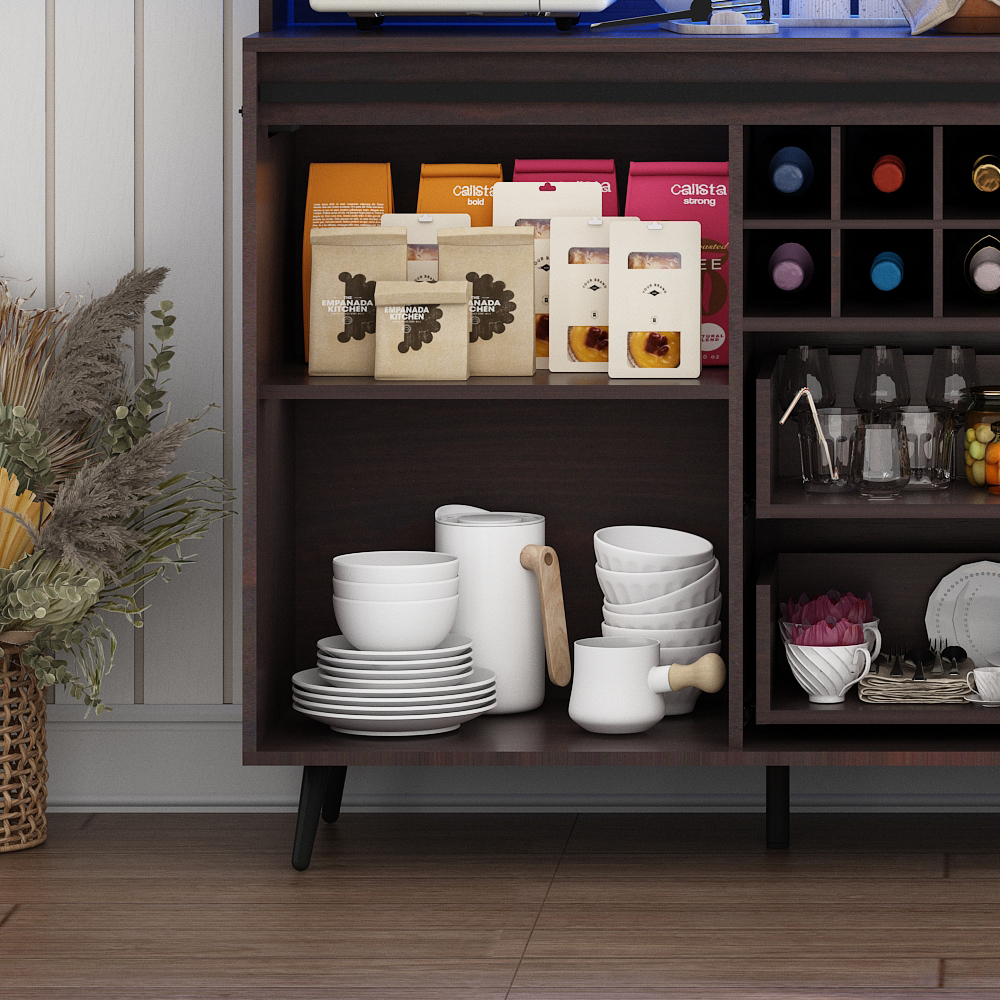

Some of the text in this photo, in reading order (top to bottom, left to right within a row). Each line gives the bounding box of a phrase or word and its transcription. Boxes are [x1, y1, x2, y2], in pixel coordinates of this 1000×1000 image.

[467, 197, 485, 206] bold
[683, 197, 716, 207] strong
[701, 241, 730, 251] asted
[583, 278, 608, 289] YOUR BRAND
[642, 283, 668, 294] YOUR BRAND
[384, 306, 430, 314] EMPANADA
[389, 313, 425, 321] KITCHEN
